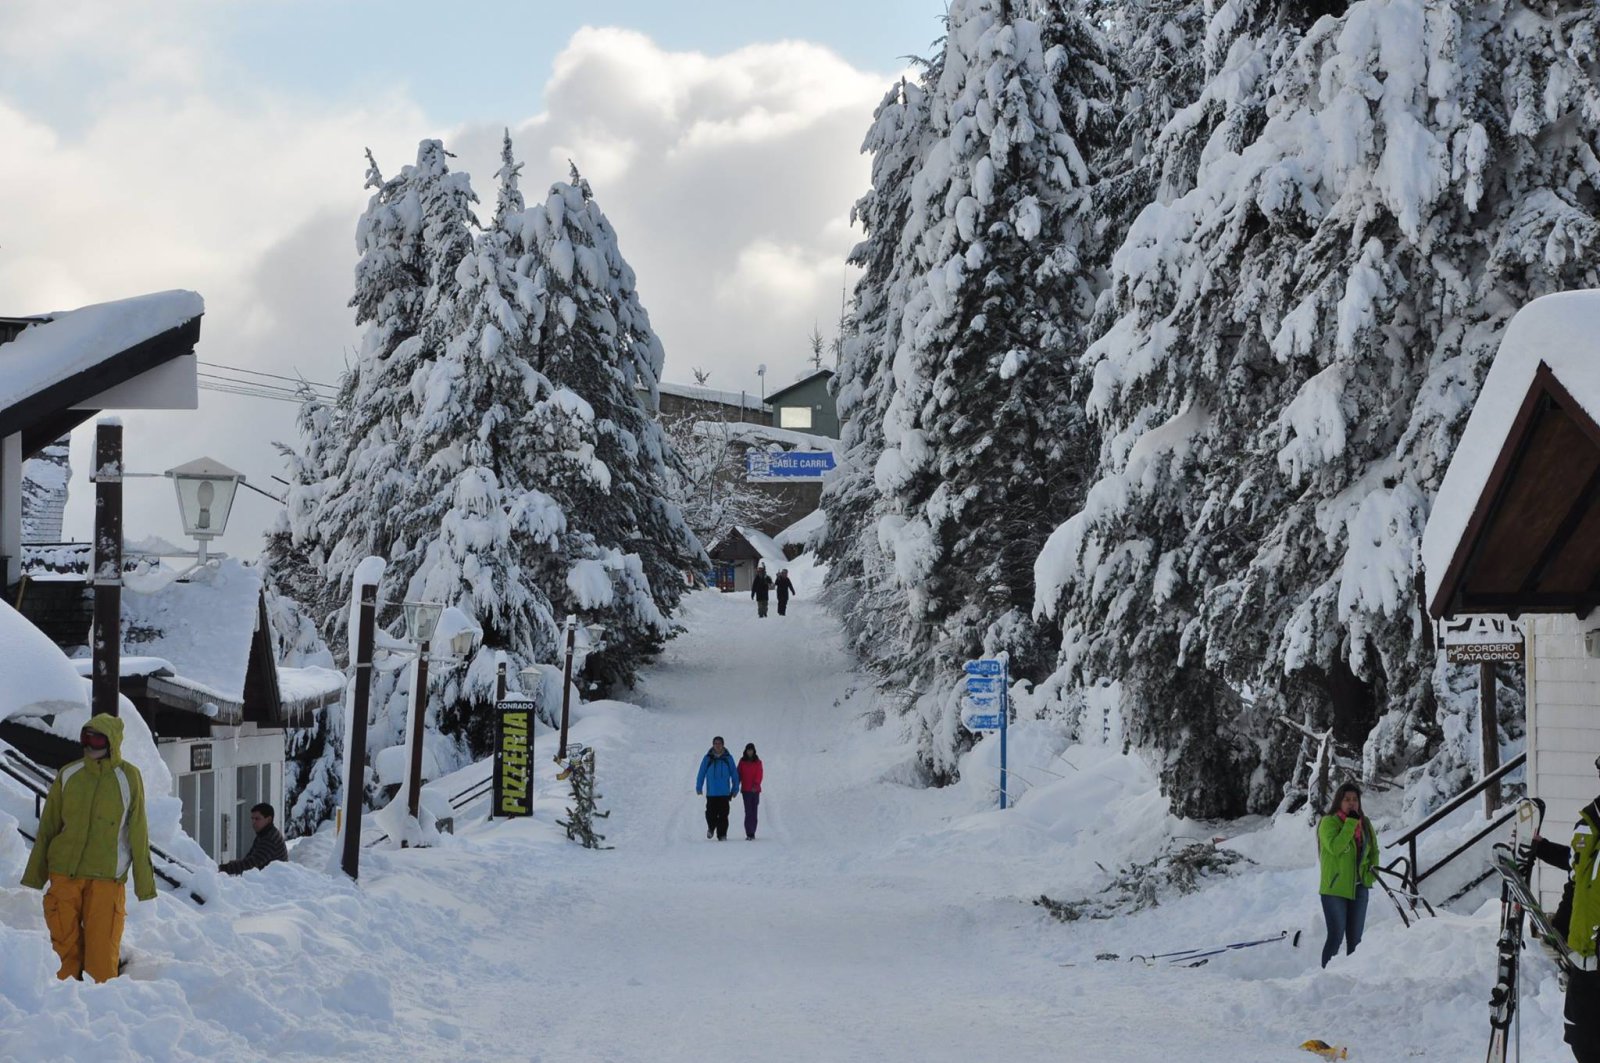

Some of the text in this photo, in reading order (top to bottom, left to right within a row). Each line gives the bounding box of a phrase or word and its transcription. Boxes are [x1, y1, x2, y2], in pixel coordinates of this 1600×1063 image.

[800, 459, 828, 468] CARRIL
[1467, 643, 1516, 653] CORDERO
[1456, 652, 1520, 661] PATAGONICO
[502, 712, 528, 814] PIZZERIA
